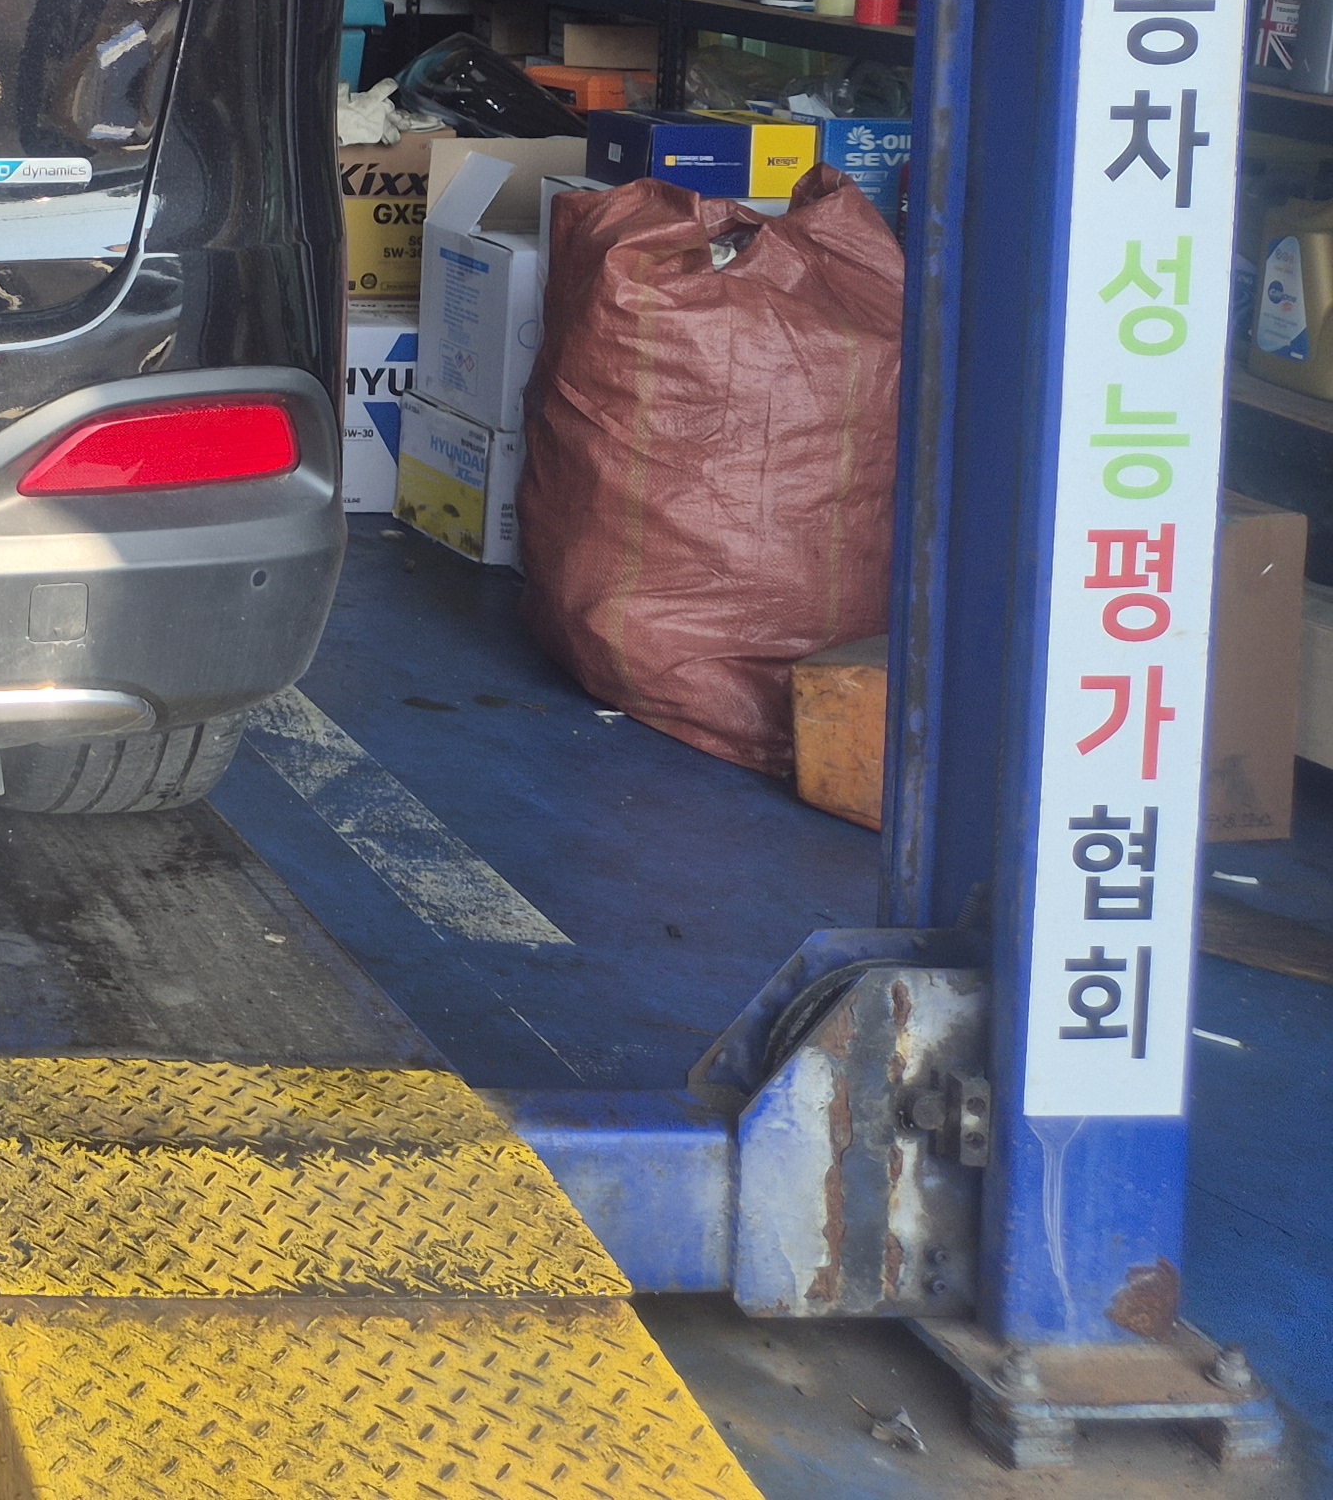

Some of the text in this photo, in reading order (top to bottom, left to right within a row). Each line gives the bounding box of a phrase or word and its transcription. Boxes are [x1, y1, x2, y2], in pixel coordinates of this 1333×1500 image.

[22, 164, 87, 179] dynamics
[340, 163, 429, 196] Kixx
[430, 434, 485, 473] HYUNDAI
